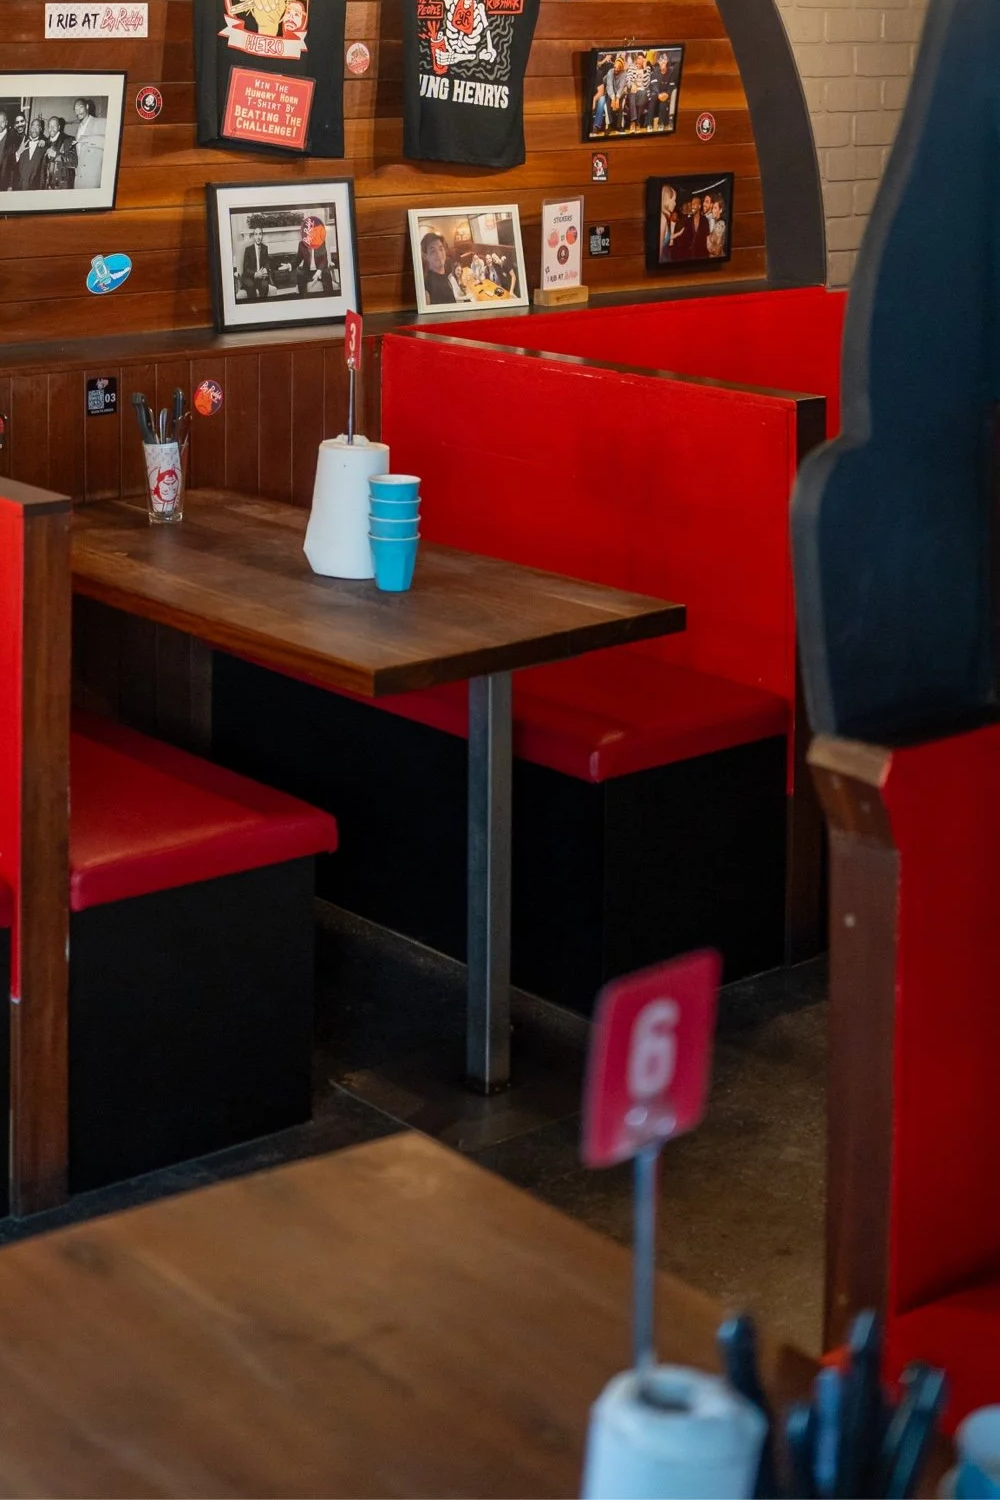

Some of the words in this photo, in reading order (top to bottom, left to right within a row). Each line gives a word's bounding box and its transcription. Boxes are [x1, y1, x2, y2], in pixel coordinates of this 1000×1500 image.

[48, 14, 53, 29] I
[56, 13, 78, 30] RIB
[82, 13, 100, 30] AT
[245, 35, 285, 55] HERO
[451, 79, 510, 109] HENRYS
[601, 238, 610, 247] 02
[349, 322, 357, 351] 3
[105, 393, 116, 403] 03
[627, 998, 681, 1102] 6
